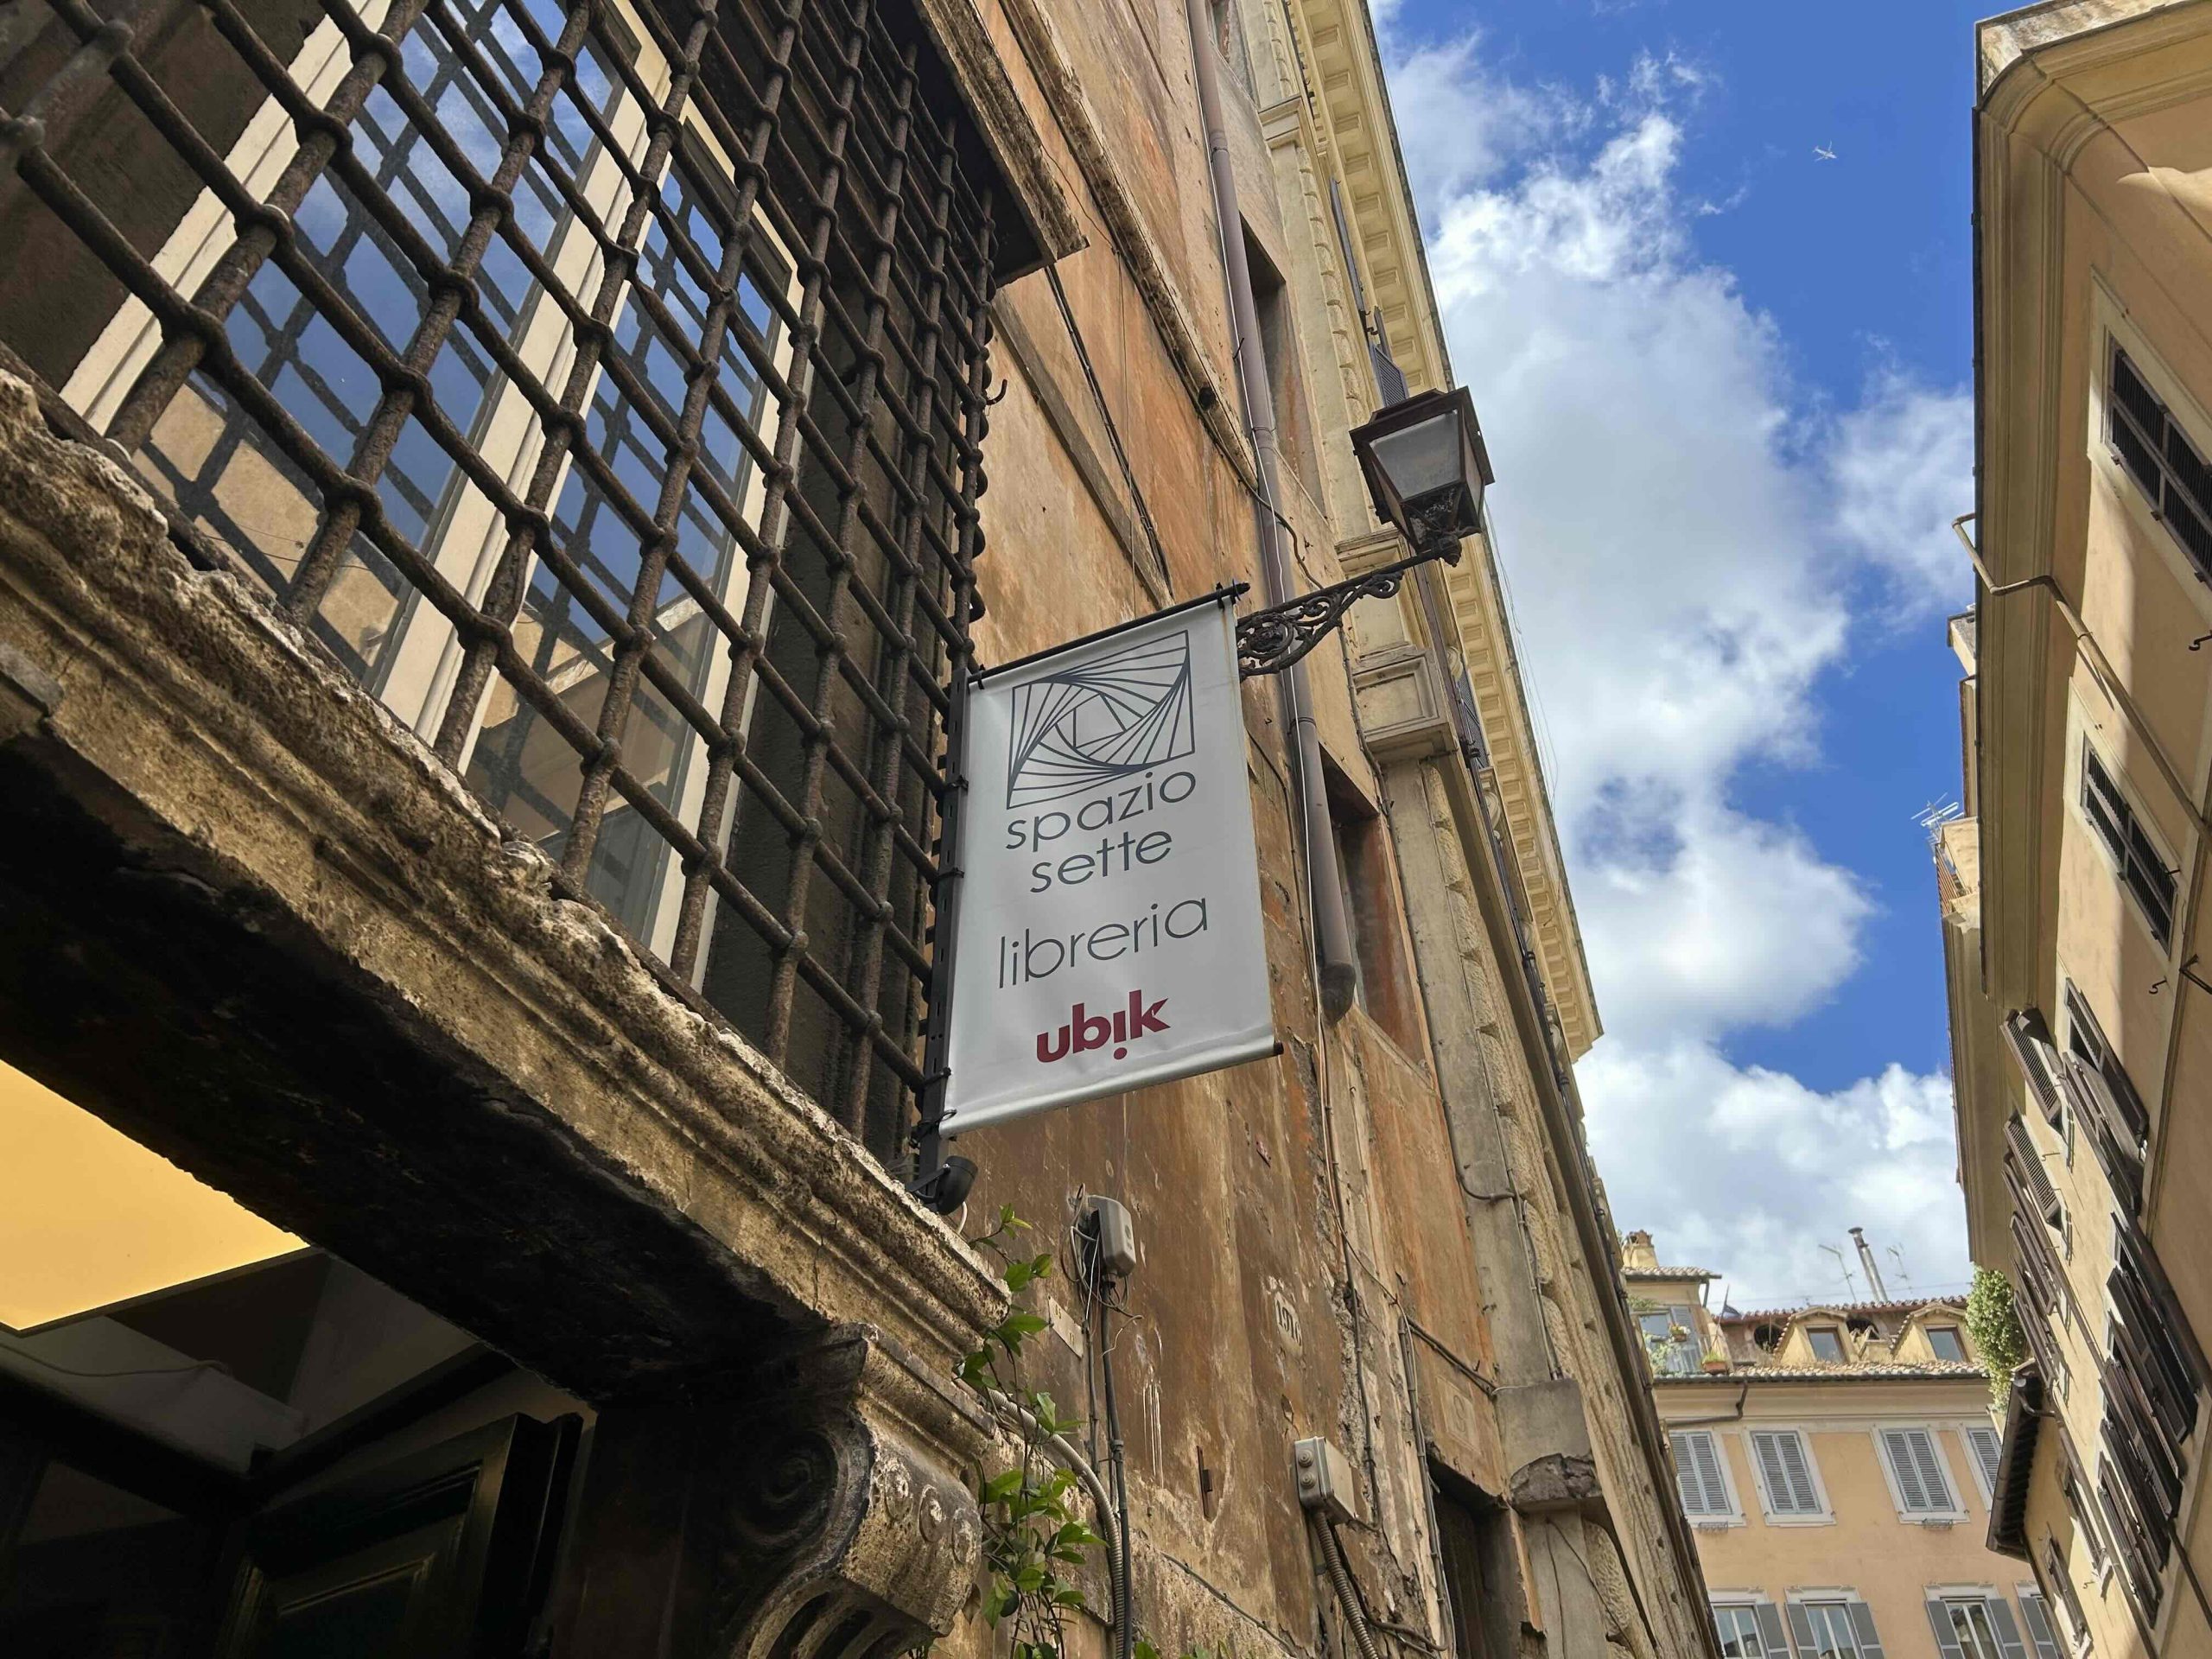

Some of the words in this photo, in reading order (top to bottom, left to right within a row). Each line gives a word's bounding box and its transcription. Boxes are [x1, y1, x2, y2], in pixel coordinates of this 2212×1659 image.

[1006, 772, 1196, 853] spazio
[1030, 831, 1173, 893] sette
[999, 898, 1208, 988] libreria
[1037, 989, 1171, 1063] ubik
